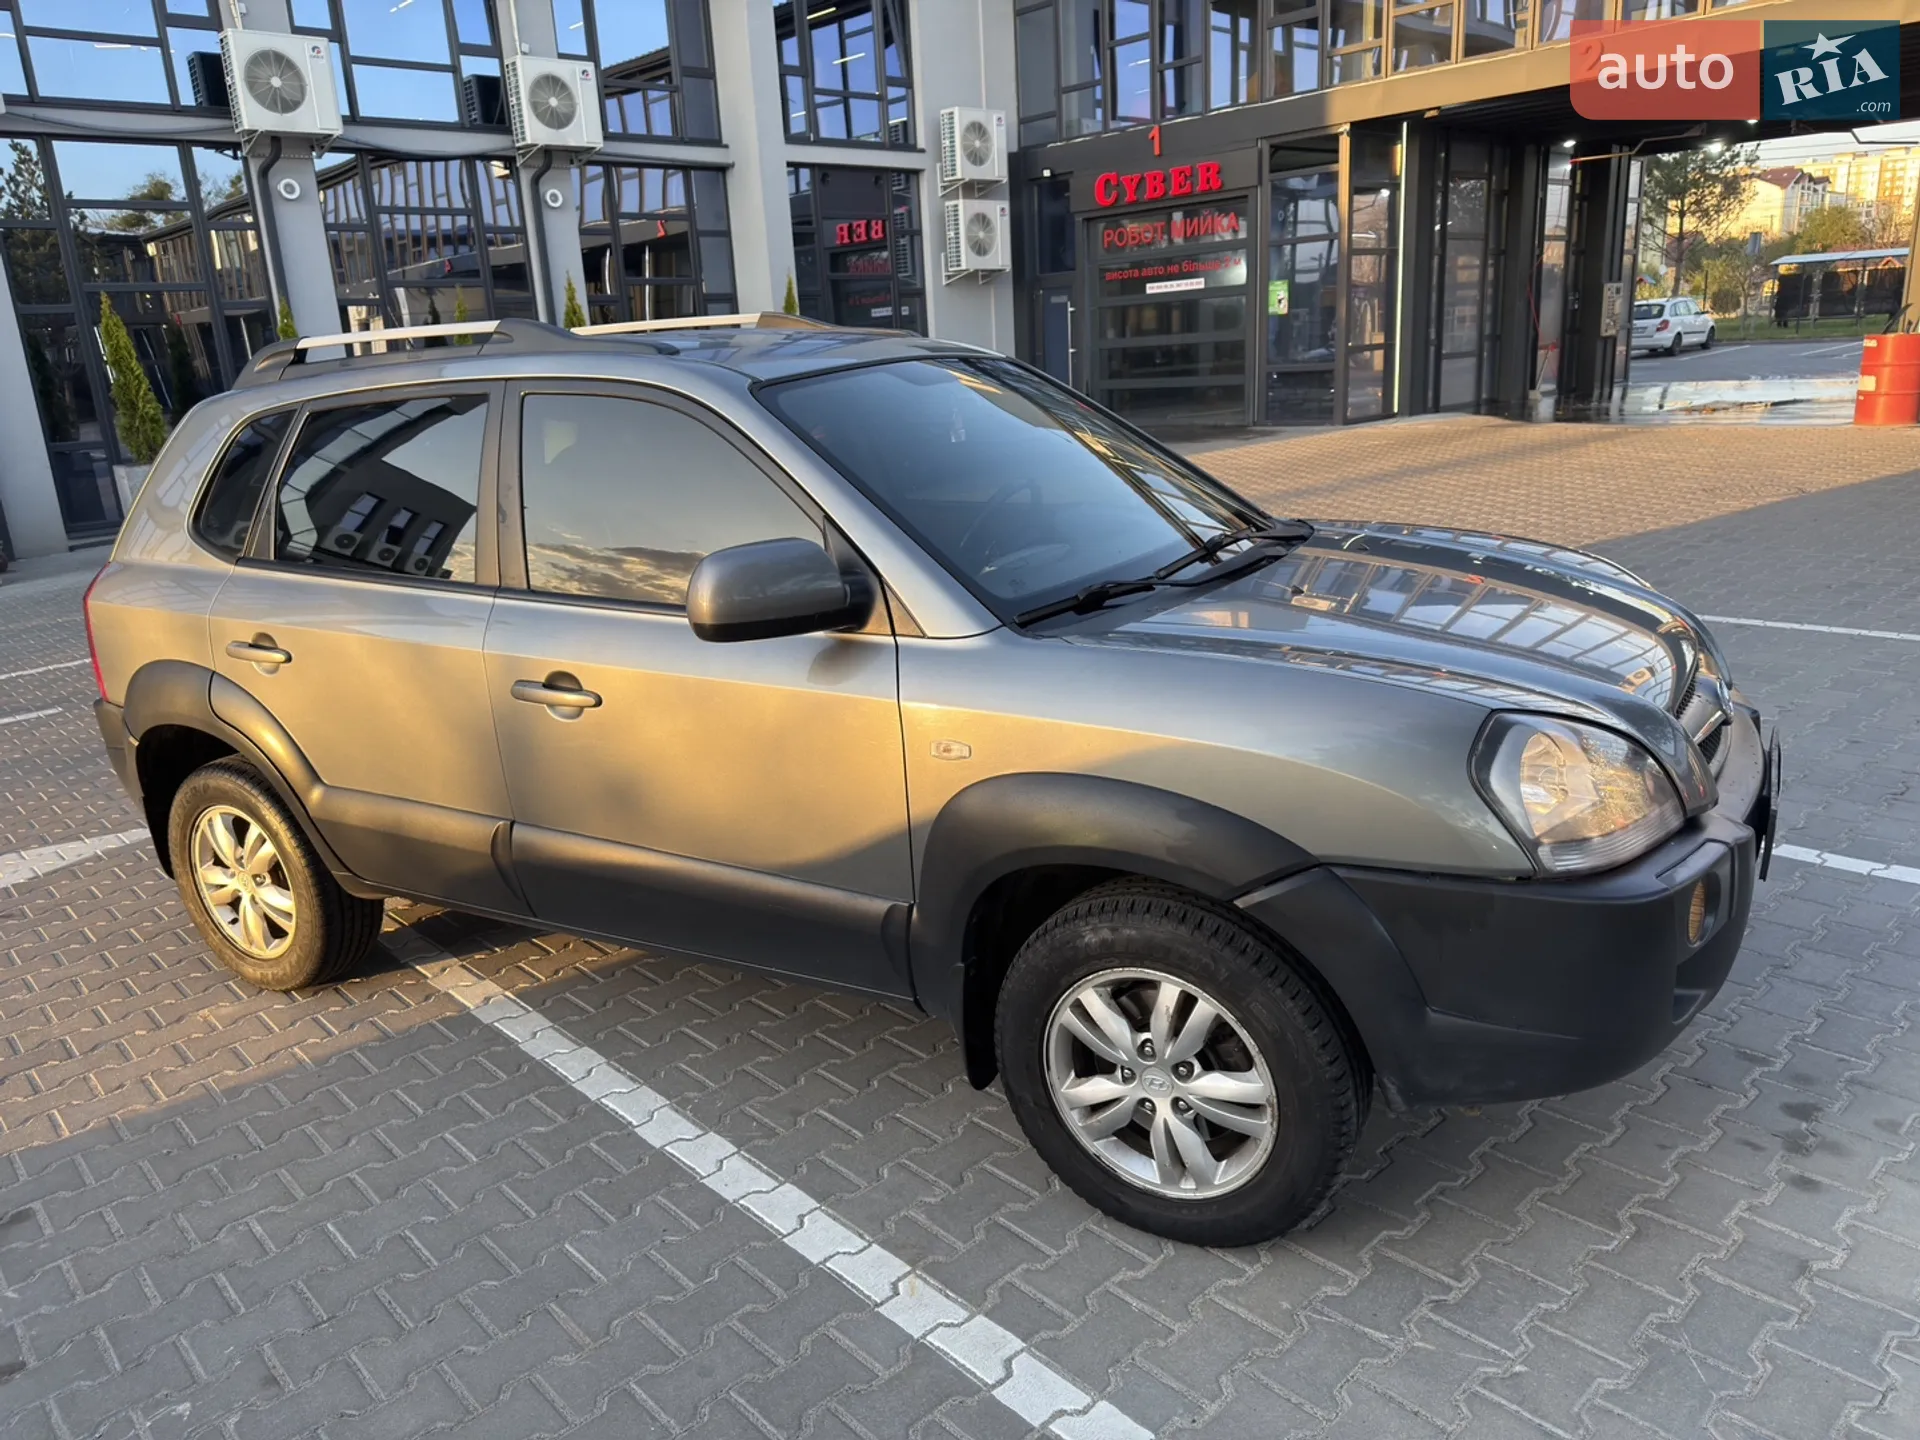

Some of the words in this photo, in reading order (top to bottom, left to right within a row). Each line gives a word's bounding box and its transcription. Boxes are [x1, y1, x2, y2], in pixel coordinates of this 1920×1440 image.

[1148, 124, 1161, 156] 1
[1094, 161, 1223, 207] CYBER
[1103, 221, 1166, 249] РОБОТ
[1170, 210, 1239, 239] МИЙКА
[1105, 268, 1139, 281] висота
[1141, 264, 1165, 277] авто
[1167, 263, 1180, 274] не
